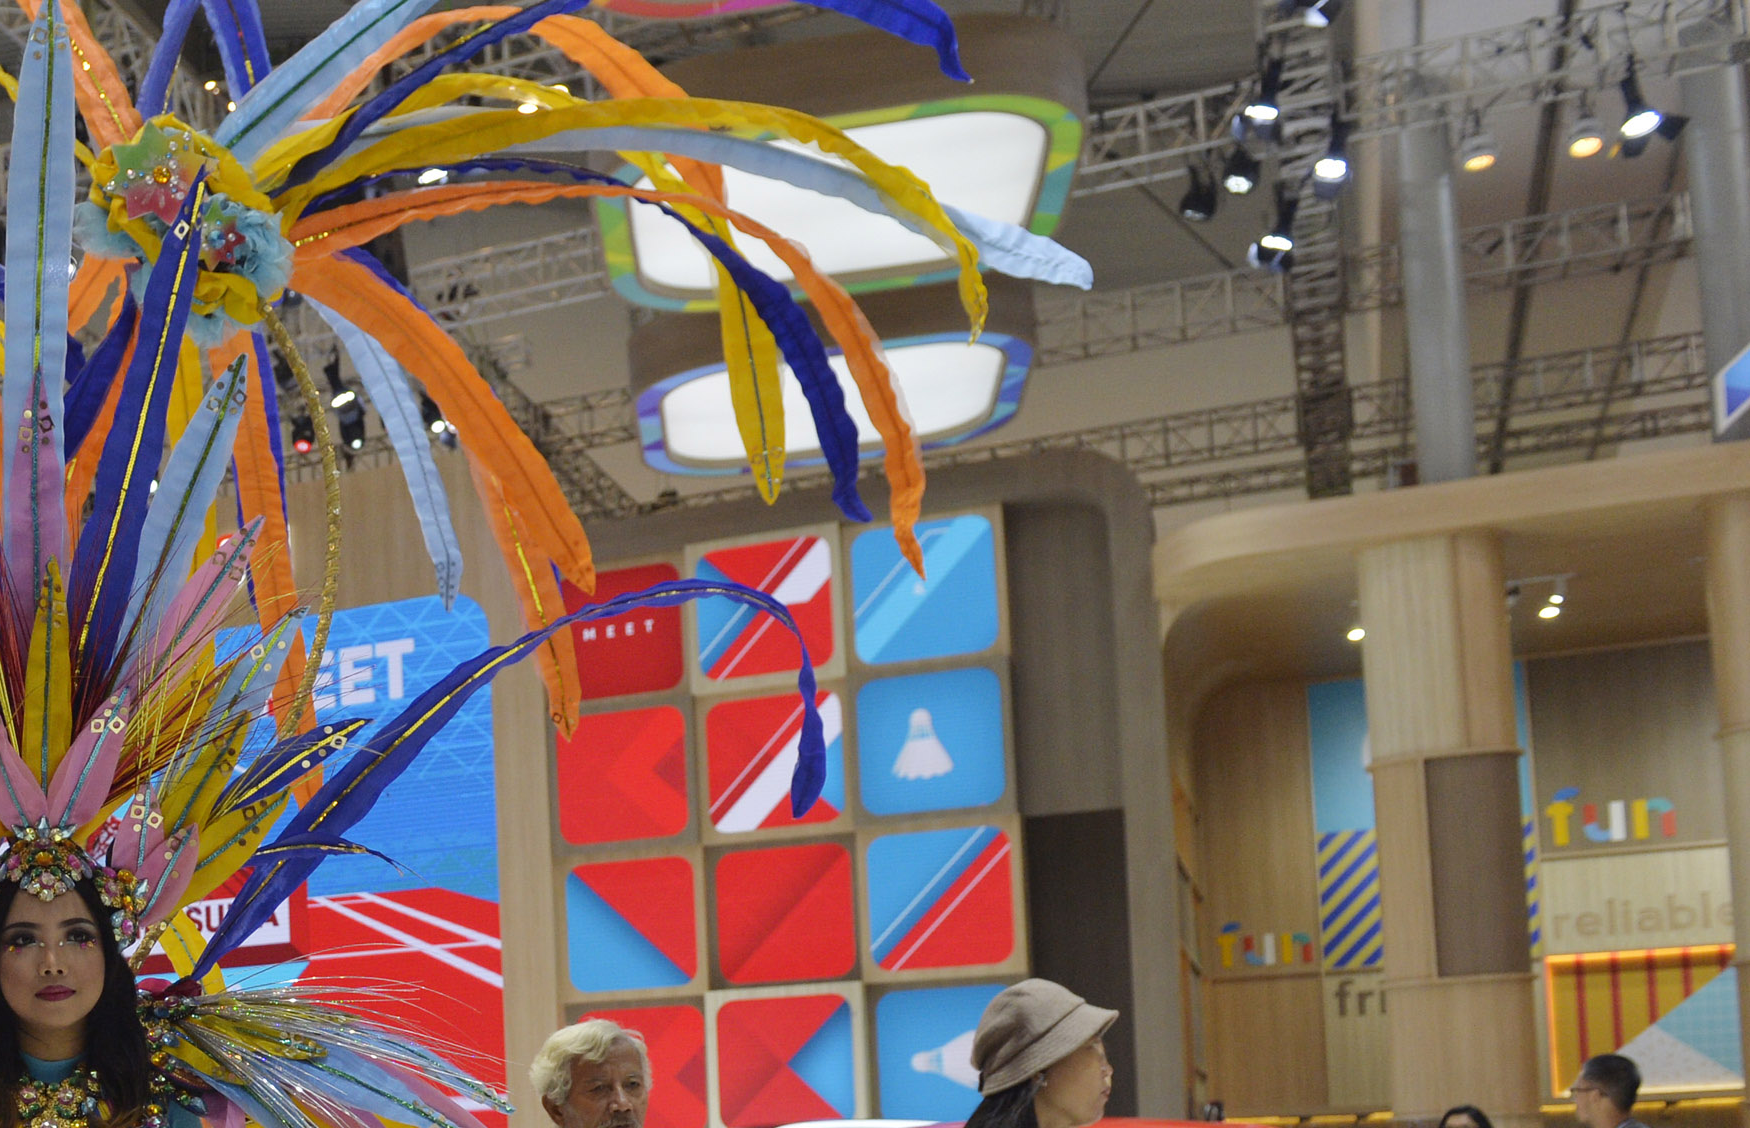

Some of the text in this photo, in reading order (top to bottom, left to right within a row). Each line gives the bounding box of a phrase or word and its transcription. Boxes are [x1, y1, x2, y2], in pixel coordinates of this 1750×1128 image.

[582, 619, 654, 641] MEET
[270, 637, 415, 713] EET
[1546, 786, 1677, 846] fun
[1216, 921, 1314, 968] fun
